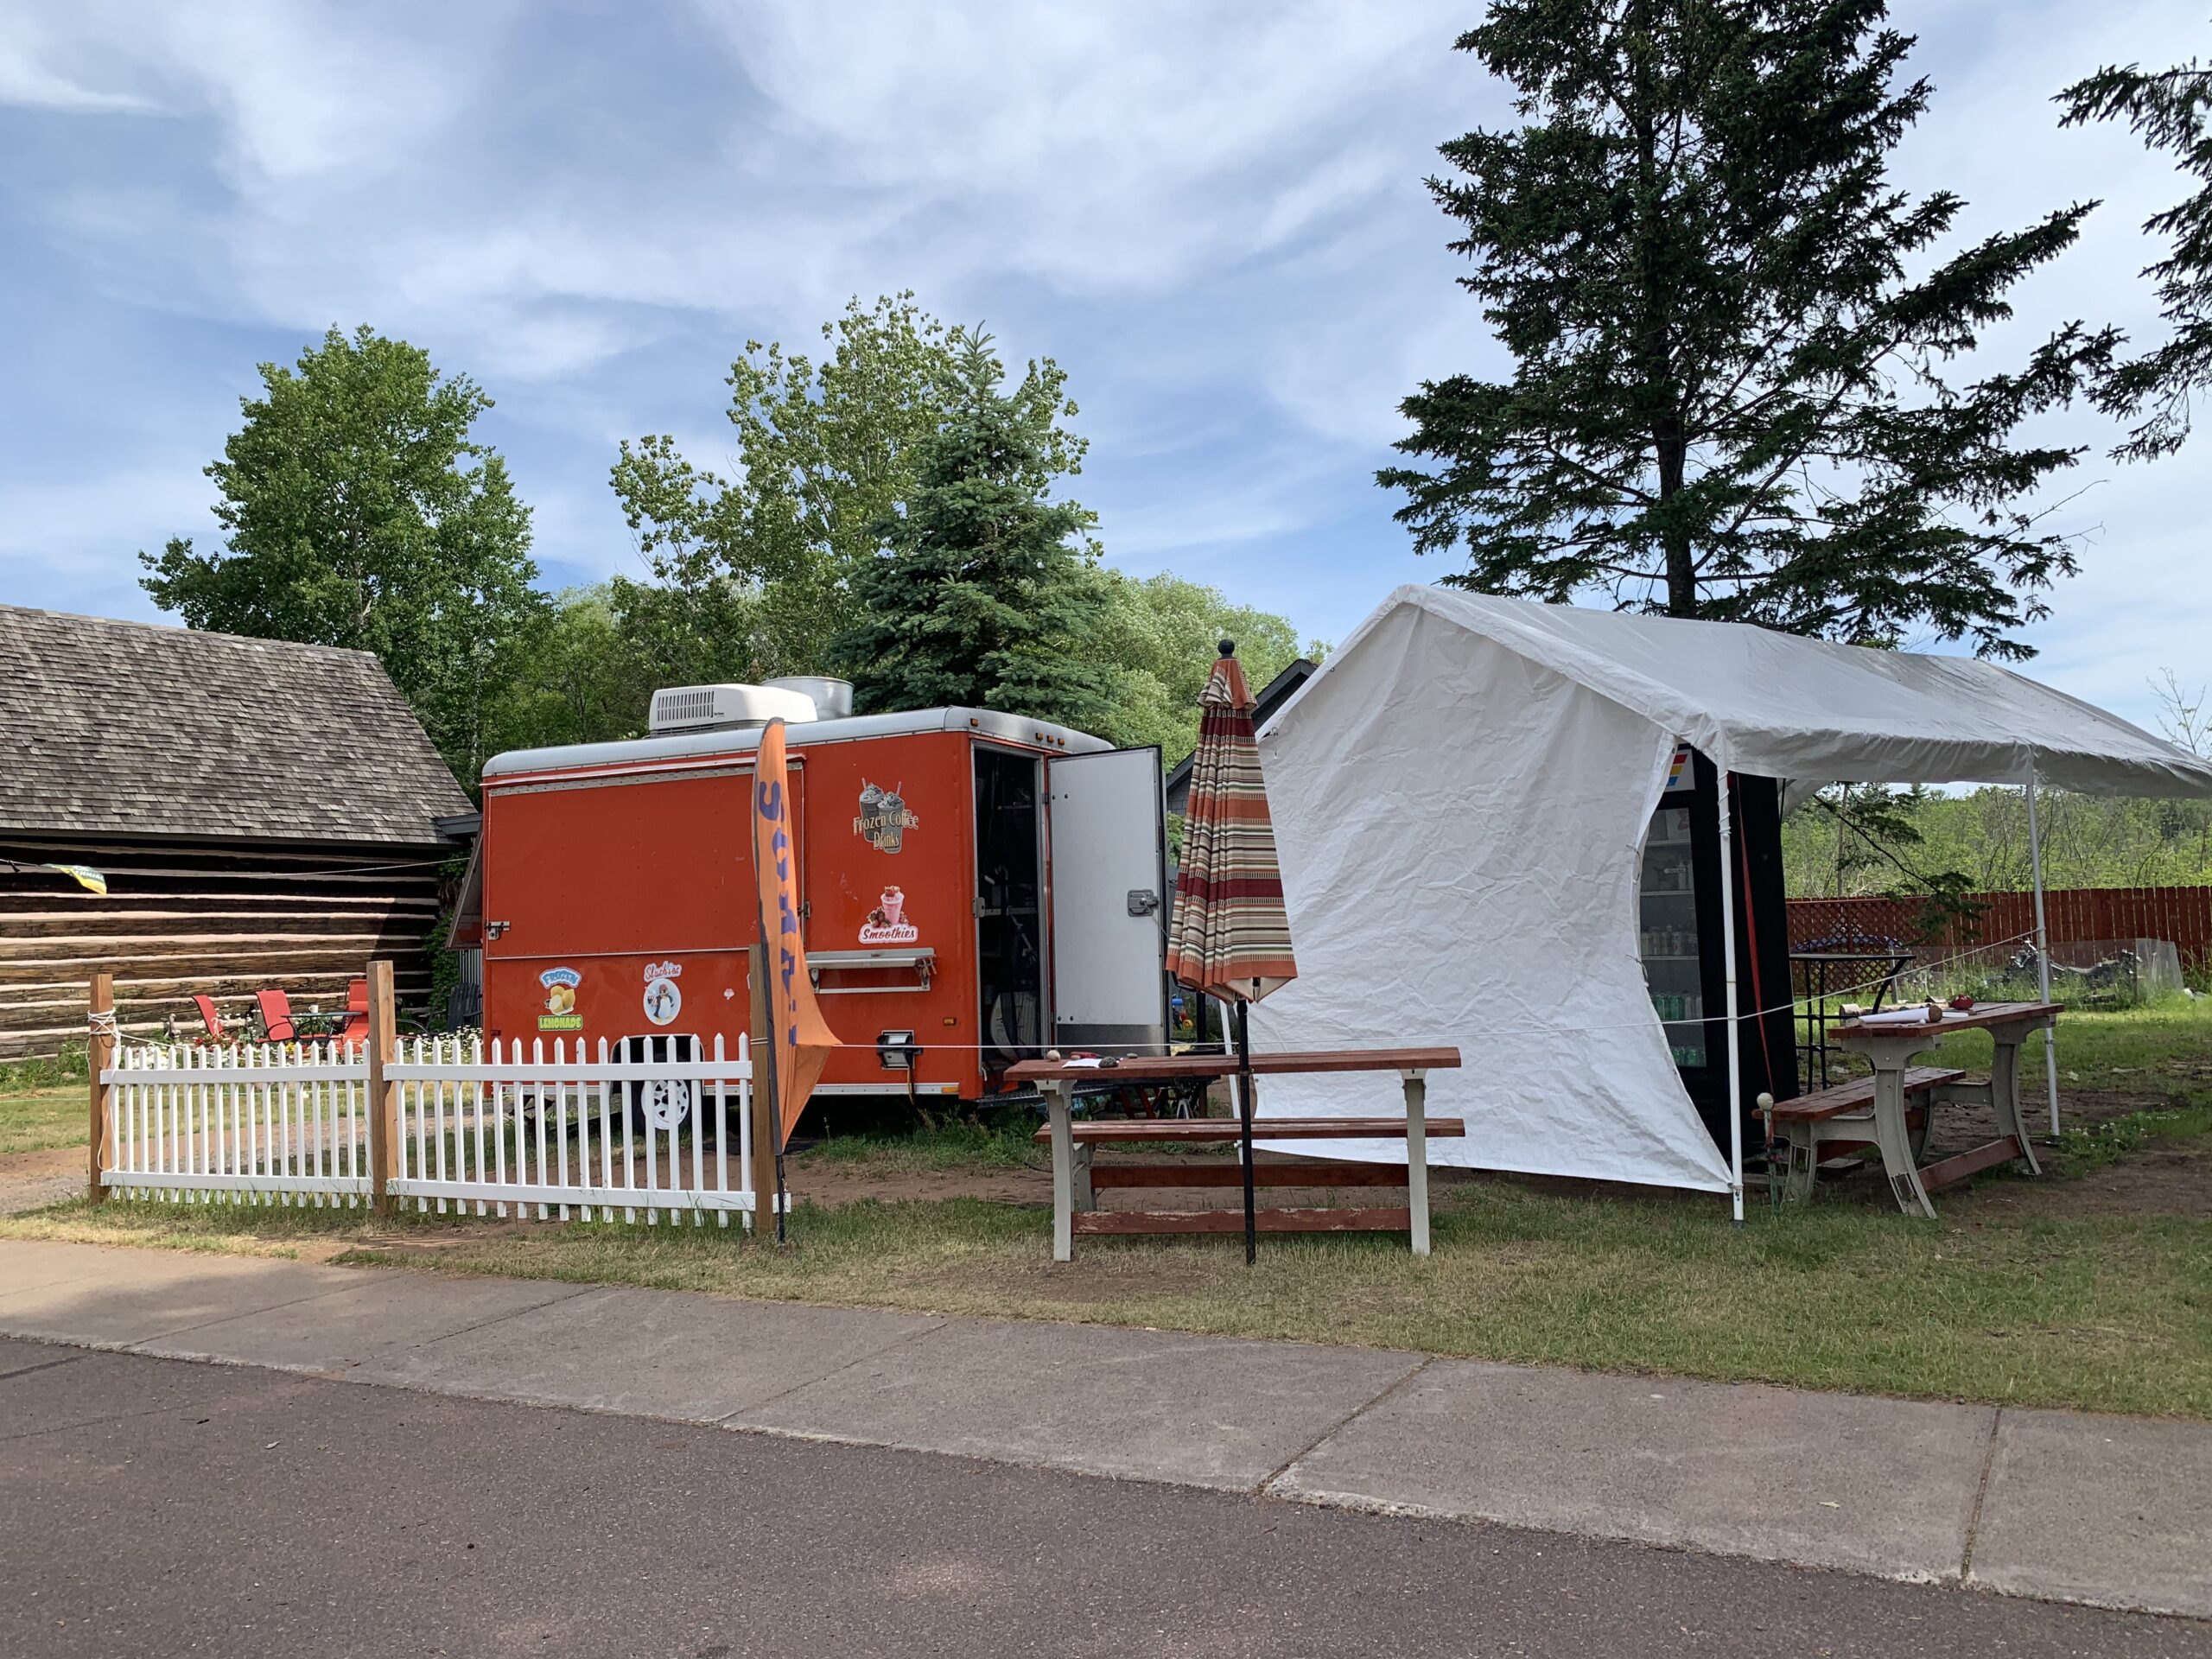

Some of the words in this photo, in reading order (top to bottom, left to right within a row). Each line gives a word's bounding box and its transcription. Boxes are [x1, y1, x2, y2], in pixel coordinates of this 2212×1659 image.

[854, 815, 887, 835] Frozen
[888, 810, 918, 830] Coffee
[874, 831, 899, 849] Drinks
[862, 927, 915, 939] Smoothies
[542, 970, 579, 985] FROZEN
[645, 963, 680, 980] Slushies
[539, 1016, 582, 1029] LEMONADE
